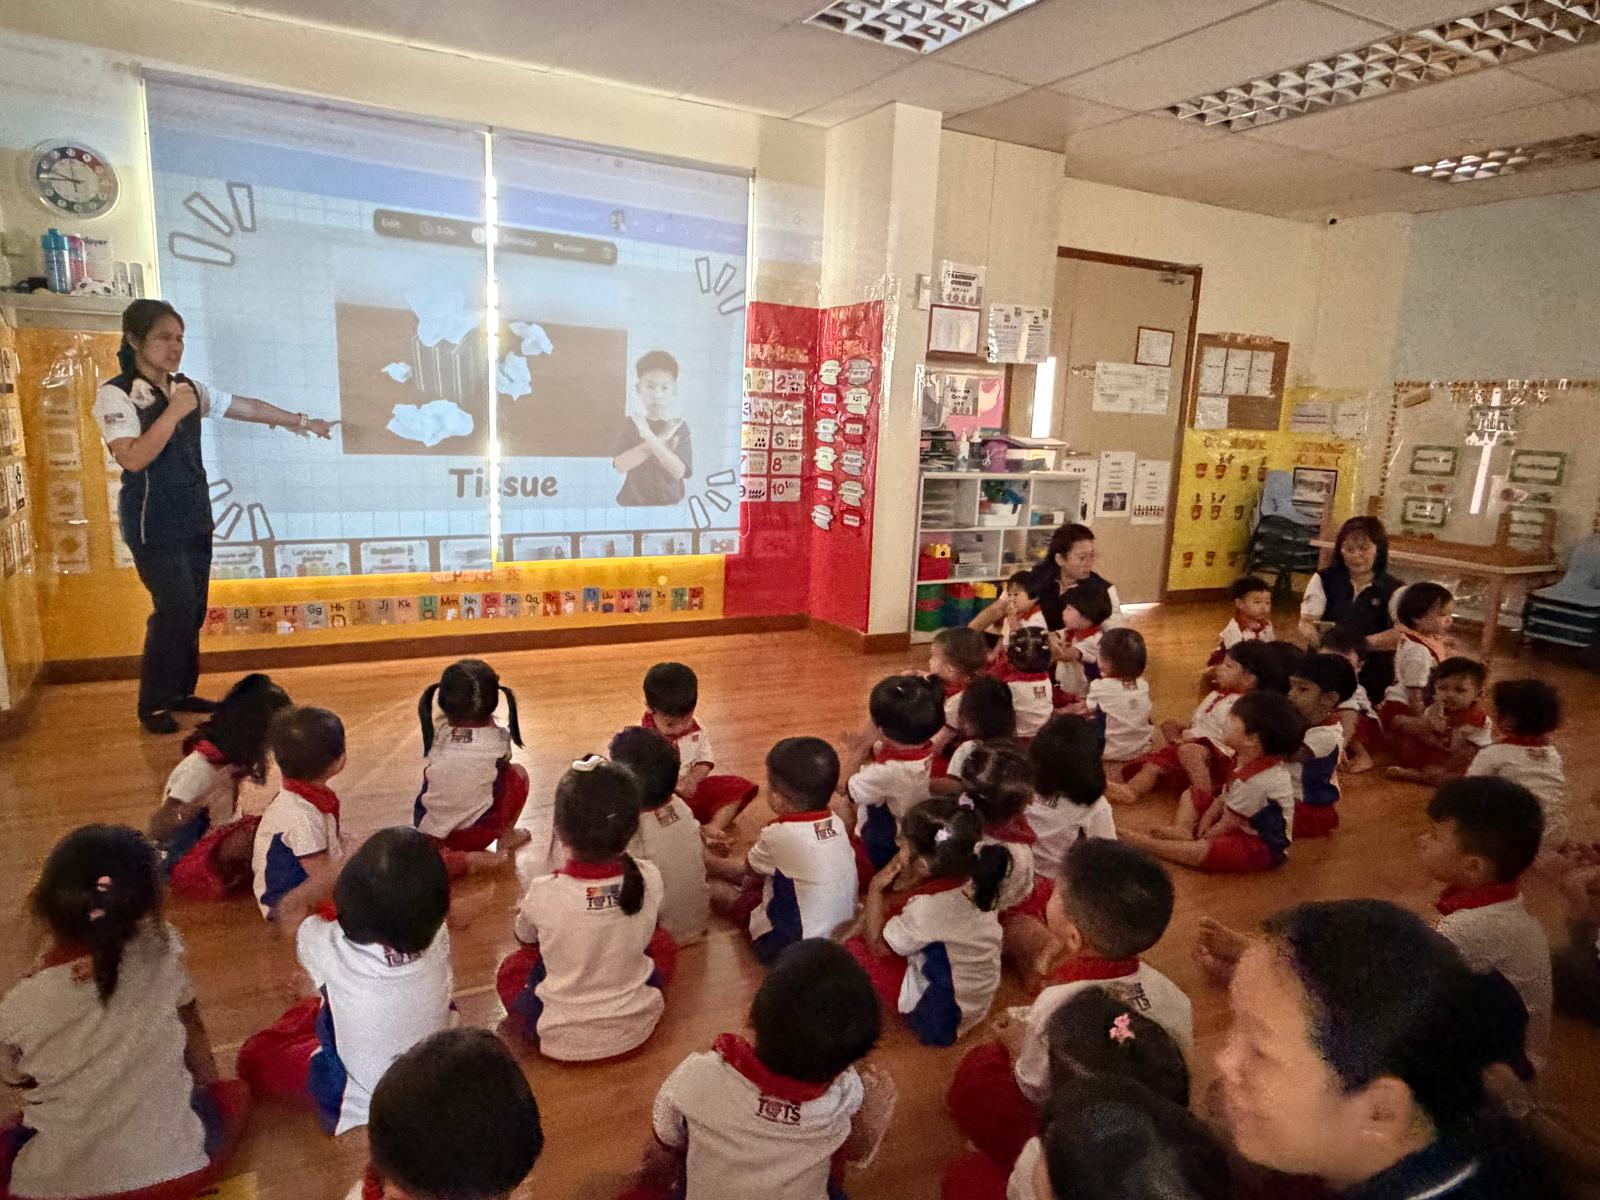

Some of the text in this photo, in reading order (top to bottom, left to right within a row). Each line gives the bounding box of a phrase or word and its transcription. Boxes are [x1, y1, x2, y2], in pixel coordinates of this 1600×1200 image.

[777, 375, 787, 390] 2
[775, 432, 785, 446] 6
[773, 457, 783, 472] 8
[449, 467, 559, 498] Tisue
[772, 483, 785, 495] 10
